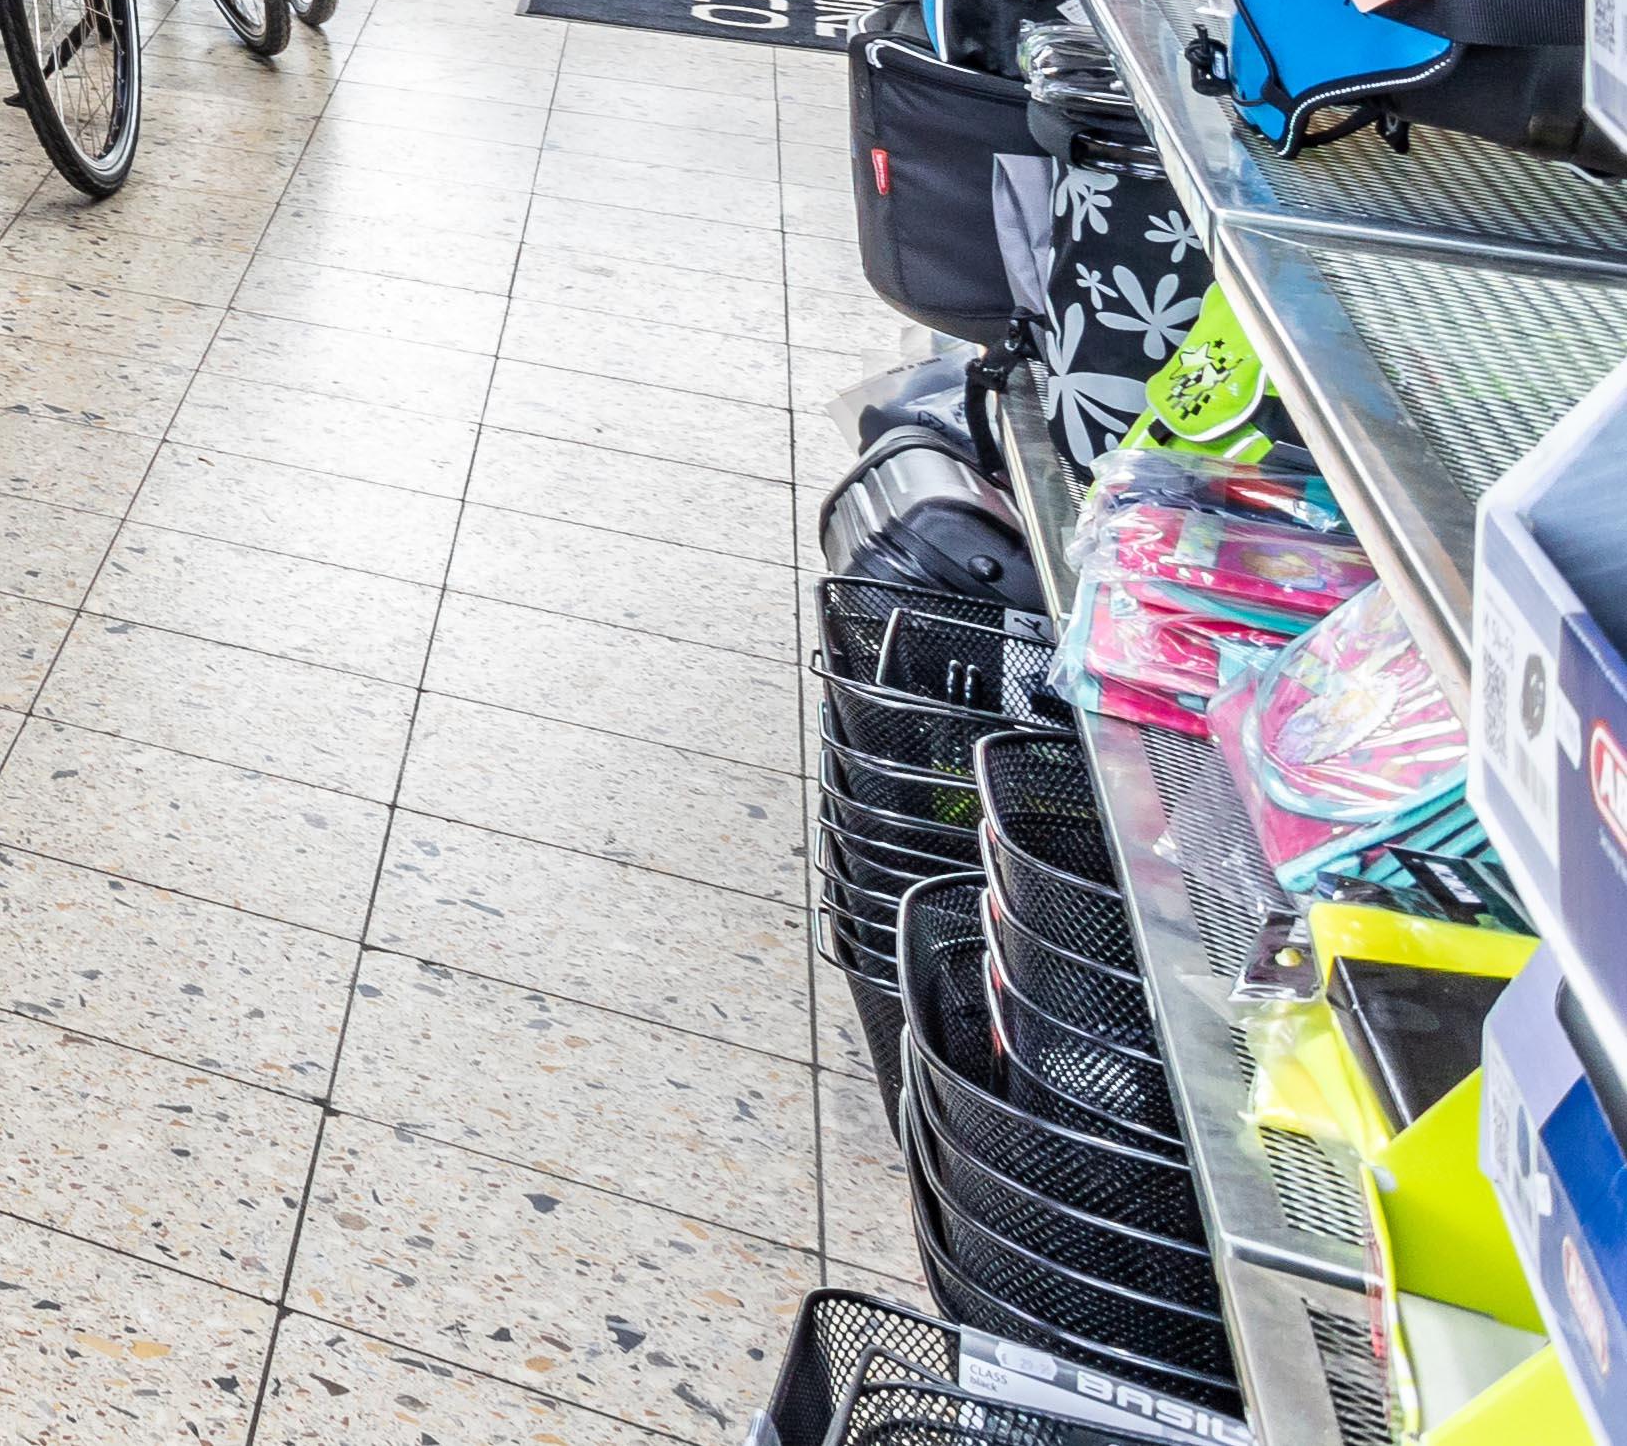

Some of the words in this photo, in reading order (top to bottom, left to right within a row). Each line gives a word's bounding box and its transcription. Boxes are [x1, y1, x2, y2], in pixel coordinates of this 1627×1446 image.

[969, 1363, 1007, 1385] CLASS
[969, 1376, 998, 1393] black
[1076, 1370, 1229, 1445] BASIL
